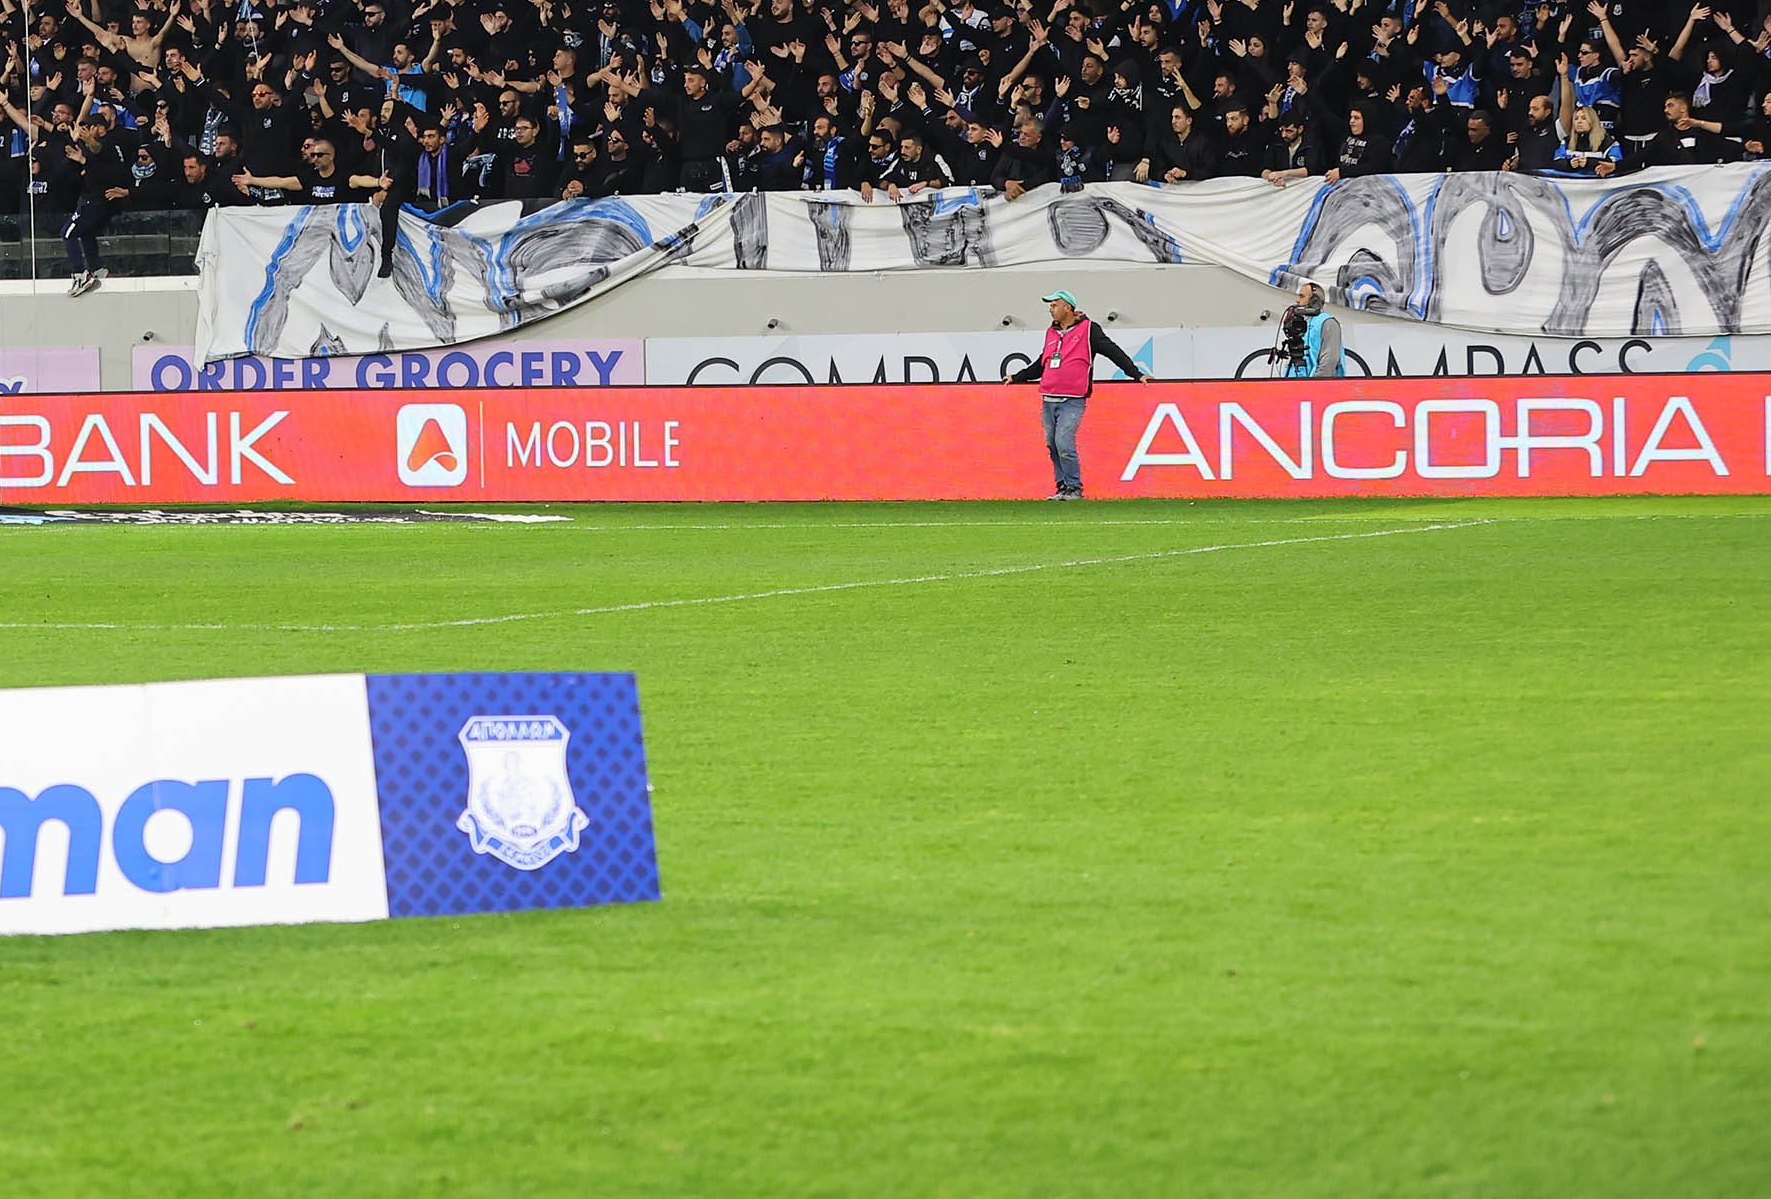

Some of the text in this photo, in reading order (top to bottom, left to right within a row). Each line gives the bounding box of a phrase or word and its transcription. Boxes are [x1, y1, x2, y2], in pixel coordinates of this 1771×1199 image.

[150, 350, 623, 392] ORDER GROCERY
[0, 410, 296, 488] BANK
[505, 420, 680, 468] MOBILE
[1118, 395, 1730, 482] ANCORIA
